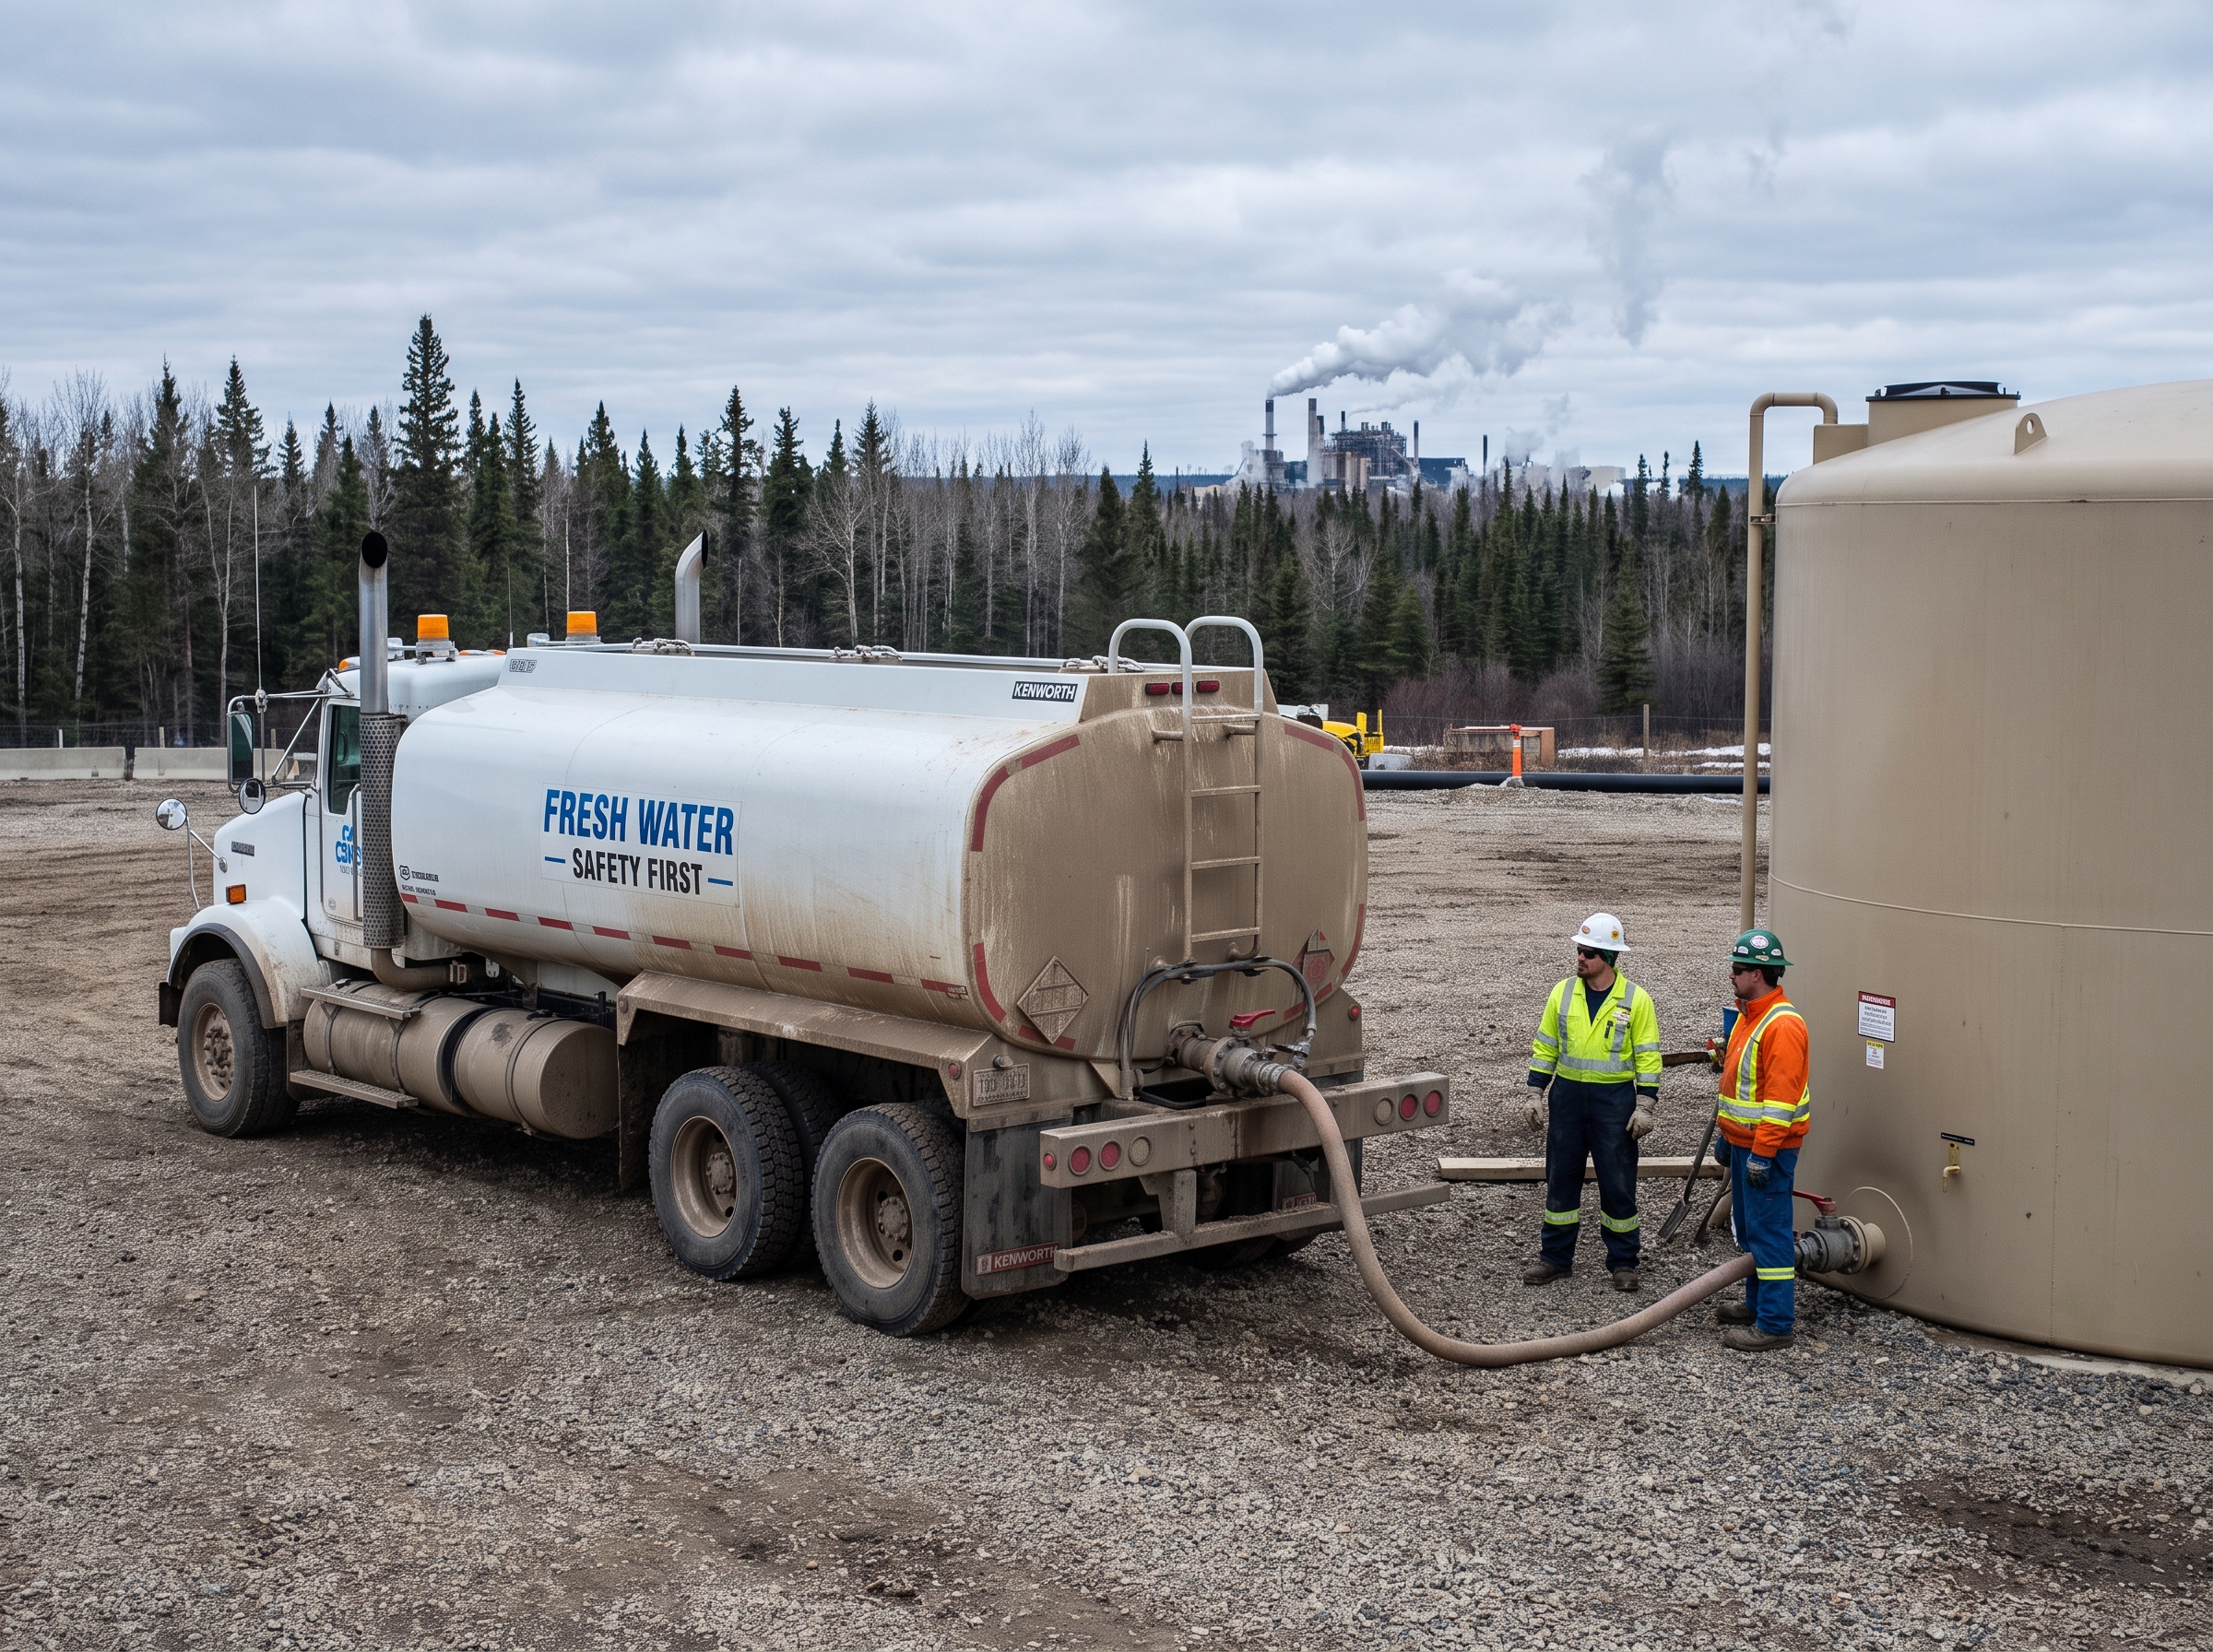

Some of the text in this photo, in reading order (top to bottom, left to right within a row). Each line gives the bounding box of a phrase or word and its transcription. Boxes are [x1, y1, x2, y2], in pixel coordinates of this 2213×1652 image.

[1013, 682, 1076, 700] KENWORTH
[543, 788, 734, 856] FRESH WATER
[572, 847, 703, 895] SAFETY FIRST
